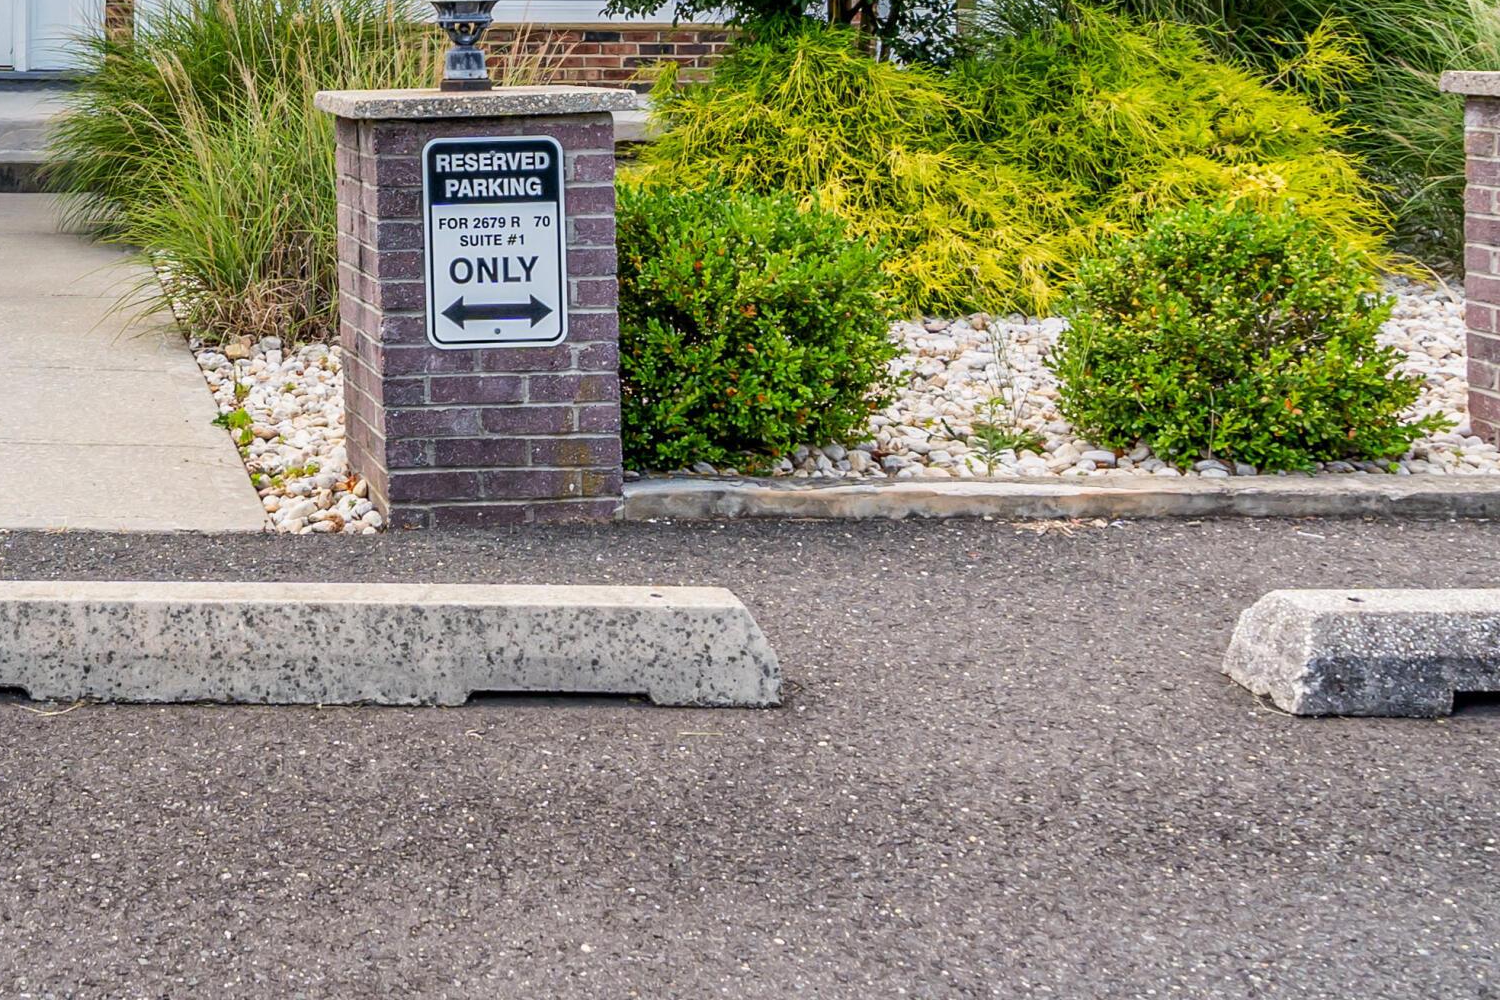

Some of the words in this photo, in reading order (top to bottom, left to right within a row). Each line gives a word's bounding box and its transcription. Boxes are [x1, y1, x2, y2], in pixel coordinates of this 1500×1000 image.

[435, 151, 550, 173] RESERVED
[444, 176, 542, 198] PARKING
[438, 217, 469, 230] FOR
[472, 216, 506, 229] 2679
[533, 215, 551, 228] 70
[459, 234, 502, 247] SUITE
[507, 234, 525, 246] #1
[449, 255, 539, 284] ONLY
